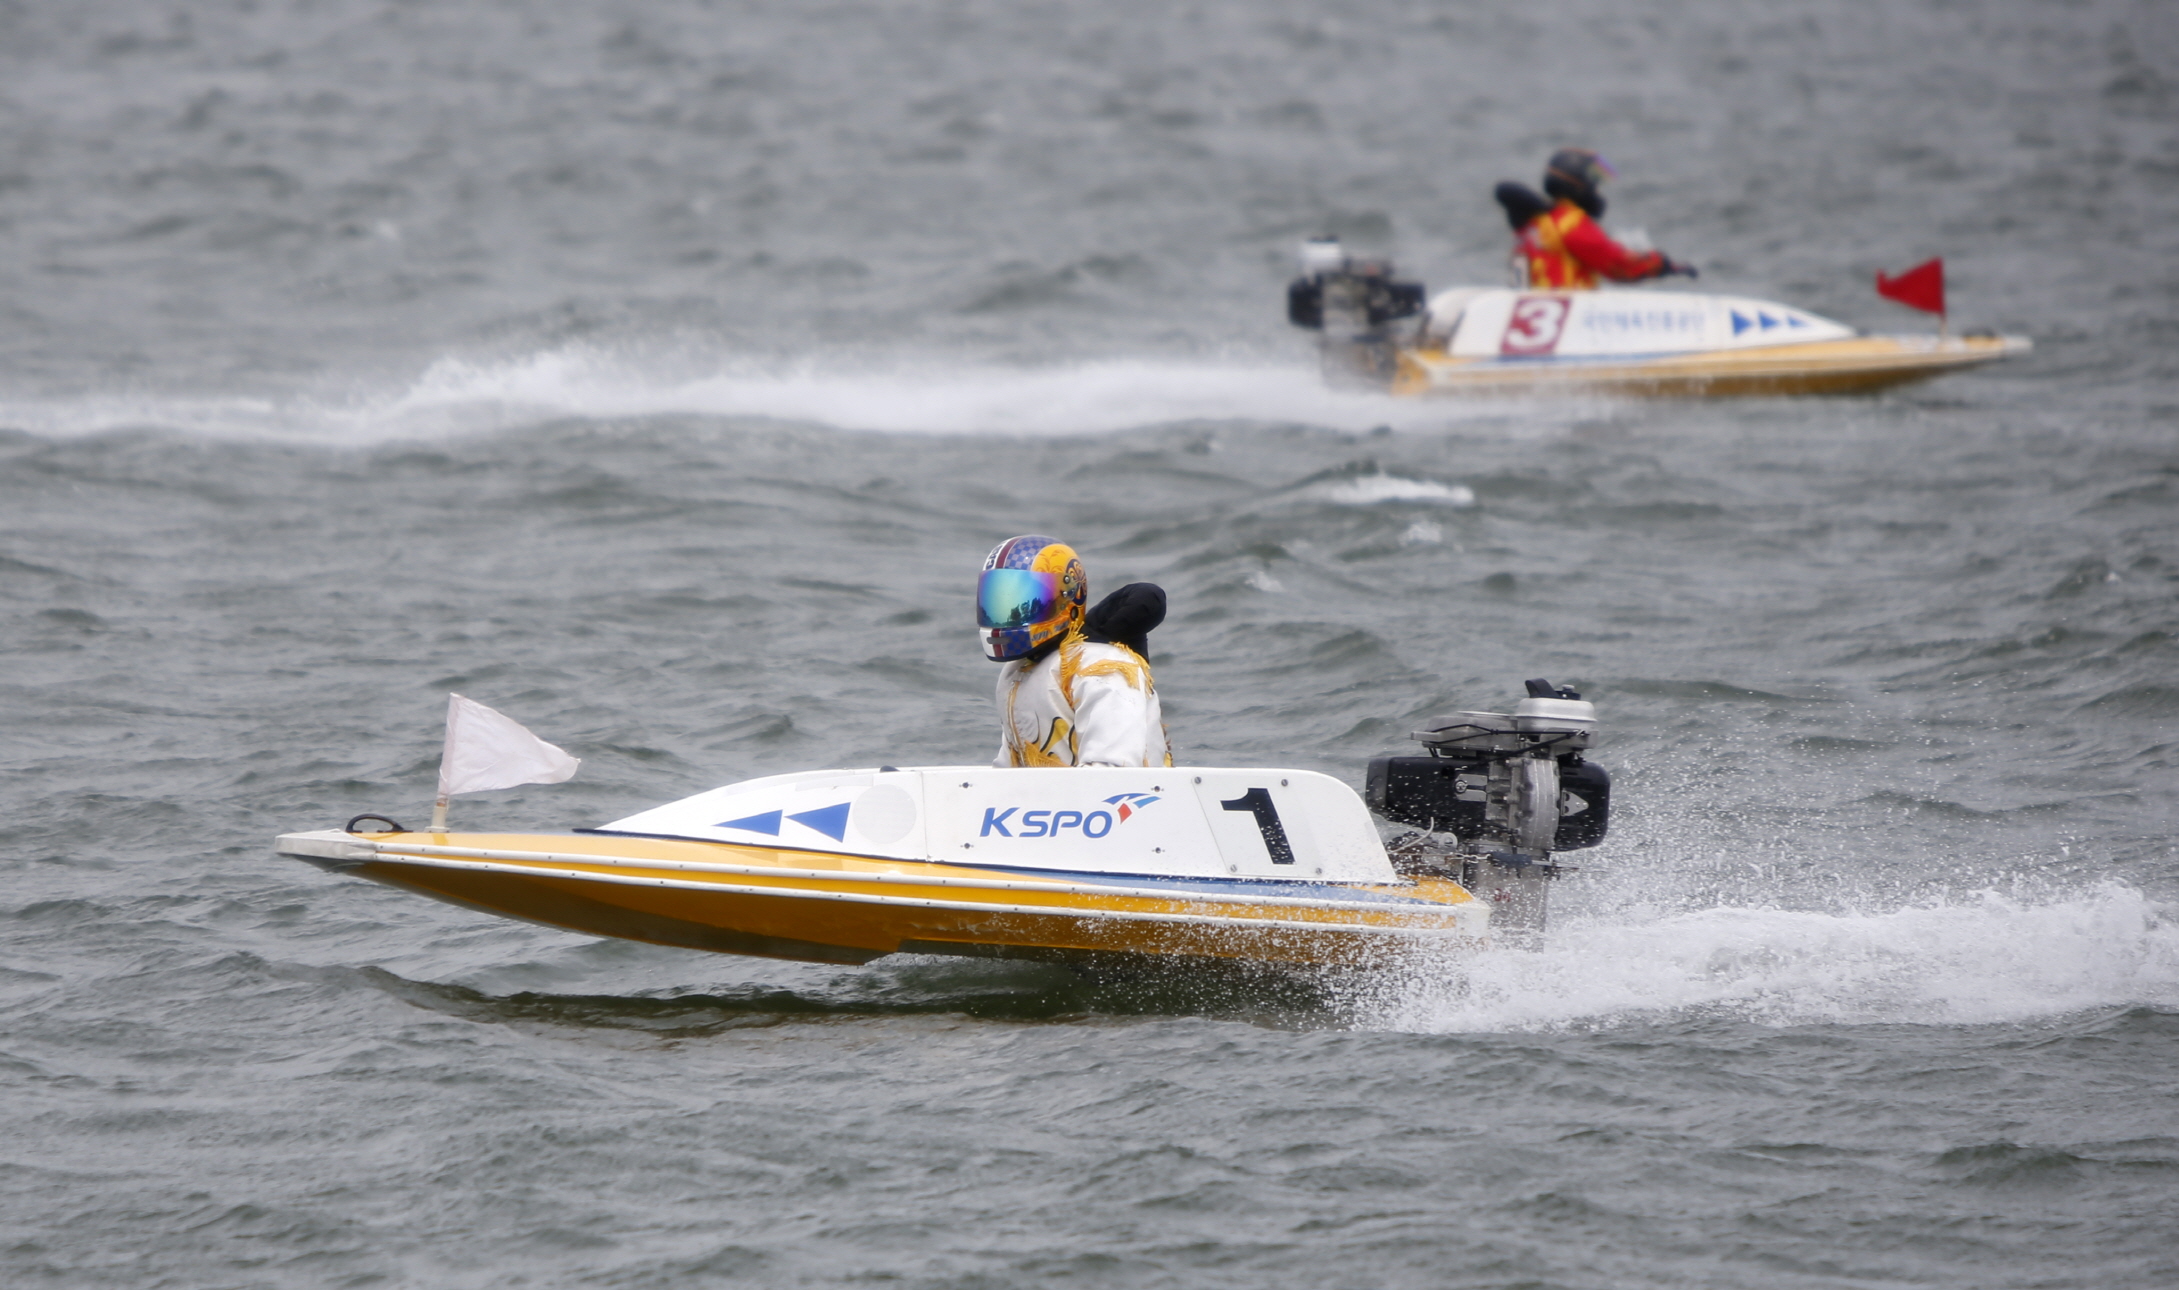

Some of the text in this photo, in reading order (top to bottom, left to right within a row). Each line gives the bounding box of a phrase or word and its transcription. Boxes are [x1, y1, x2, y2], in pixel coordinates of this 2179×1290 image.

[1507, 299, 1564, 349] 3
[979, 806, 1114, 839] KSPO
[1220, 787, 1297, 865] 1
